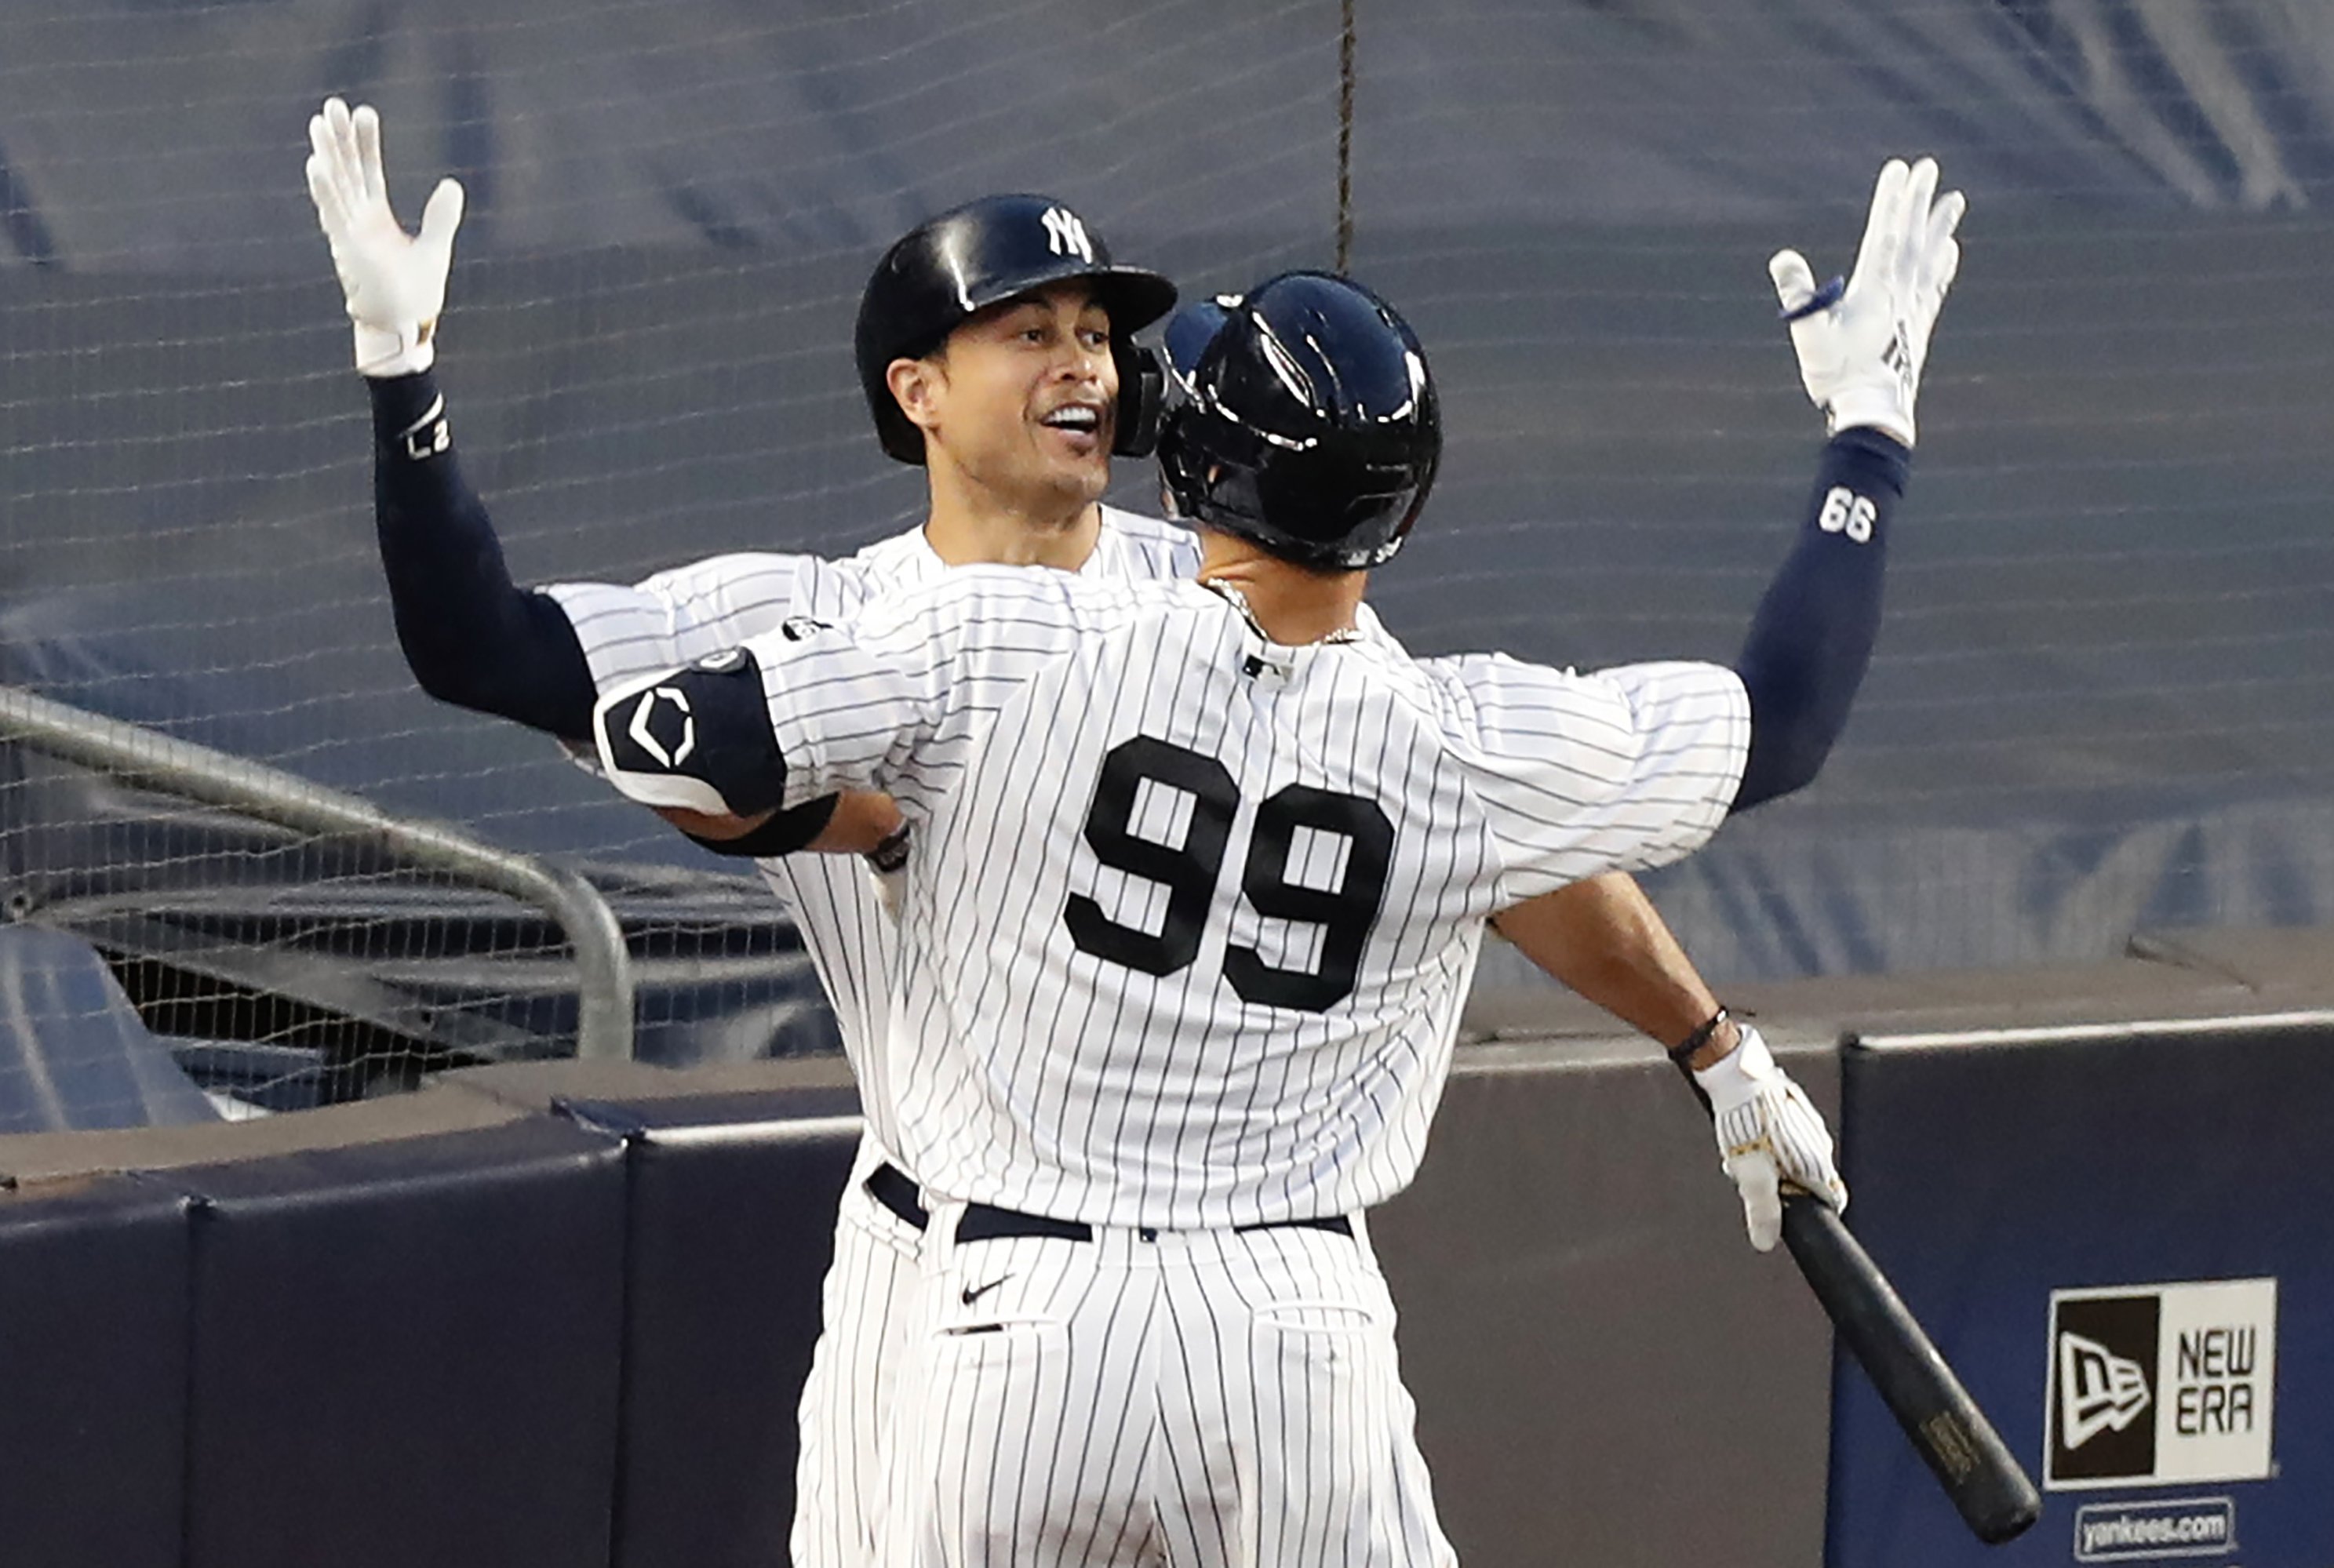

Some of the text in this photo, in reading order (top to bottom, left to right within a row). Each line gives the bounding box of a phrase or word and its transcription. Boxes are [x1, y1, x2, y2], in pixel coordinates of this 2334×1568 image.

[1041, 207, 1092, 264] NY
[1063, 734, 1395, 1013] 99
[2178, 1326, 2256, 1381] NEW
[2176, 1384, 2252, 1436] ERA
[2084, 1515, 2226, 1552] yankees.com
